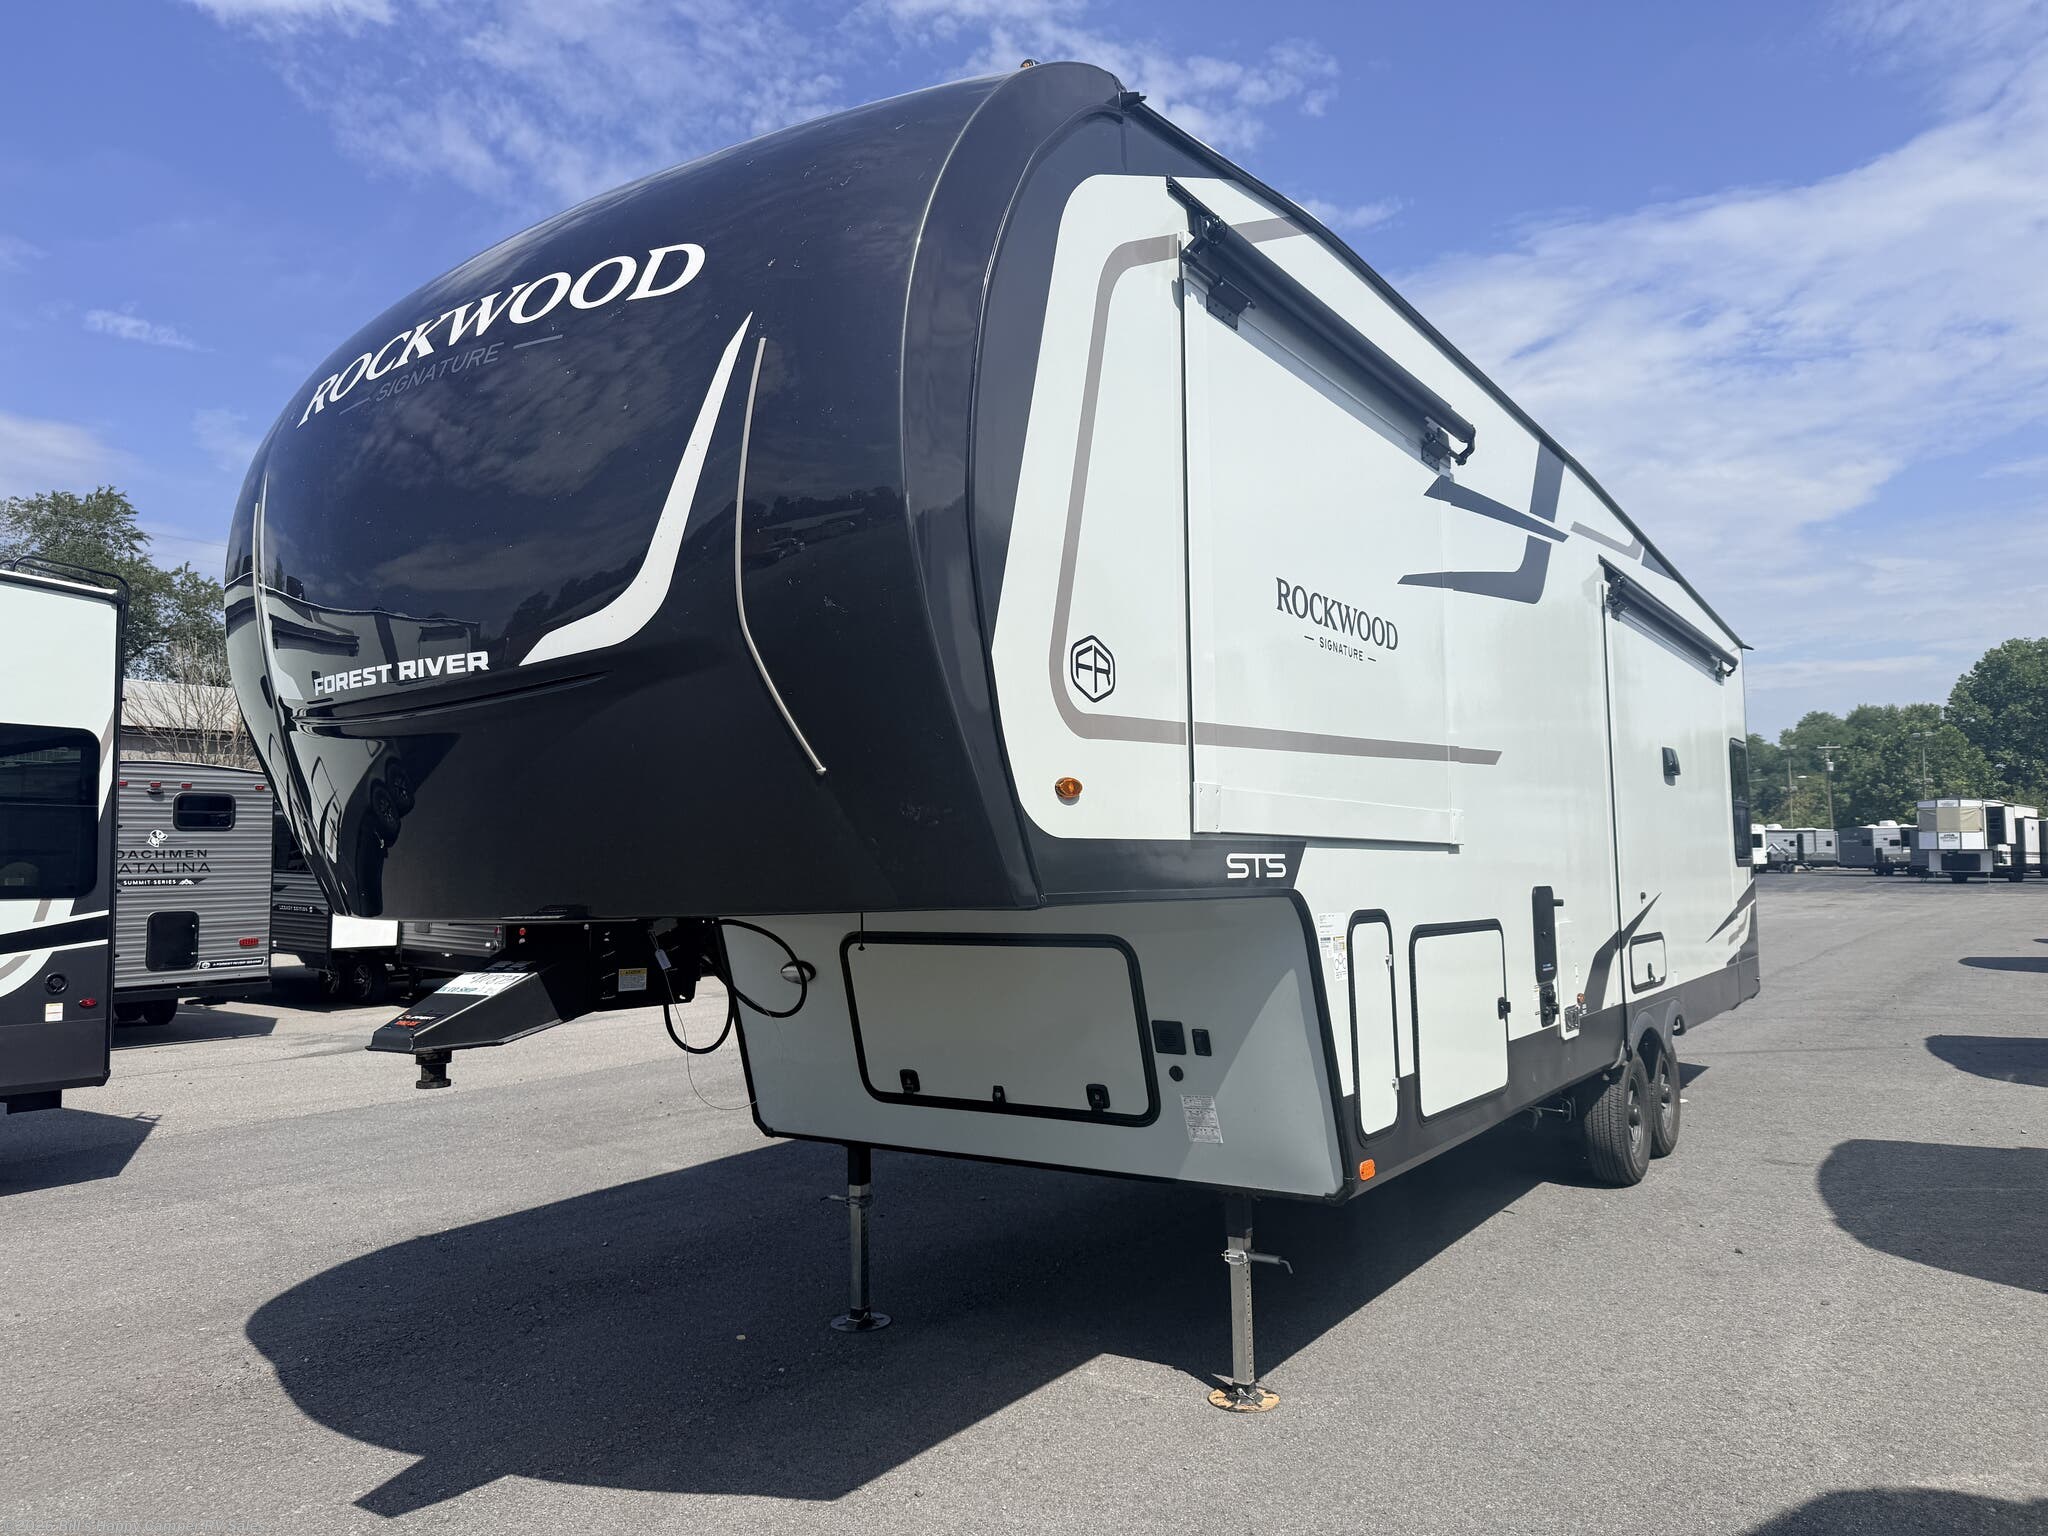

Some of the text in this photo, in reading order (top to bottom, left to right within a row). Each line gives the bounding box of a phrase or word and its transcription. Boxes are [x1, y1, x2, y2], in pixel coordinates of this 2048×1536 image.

[297, 243, 706, 429] ROCKWOOD
[375, 341, 504, 402] SIGNATURE
[1276, 577, 1398, 650] ROCKWOOD
[1319, 637, 1364, 661] SIGNATURE
[313, 651, 490, 696] FOREST RIVER
[117, 849, 208, 859] OACHMEN
[118, 862, 211, 874] ATALINA
[1226, 853, 1287, 879] STS
